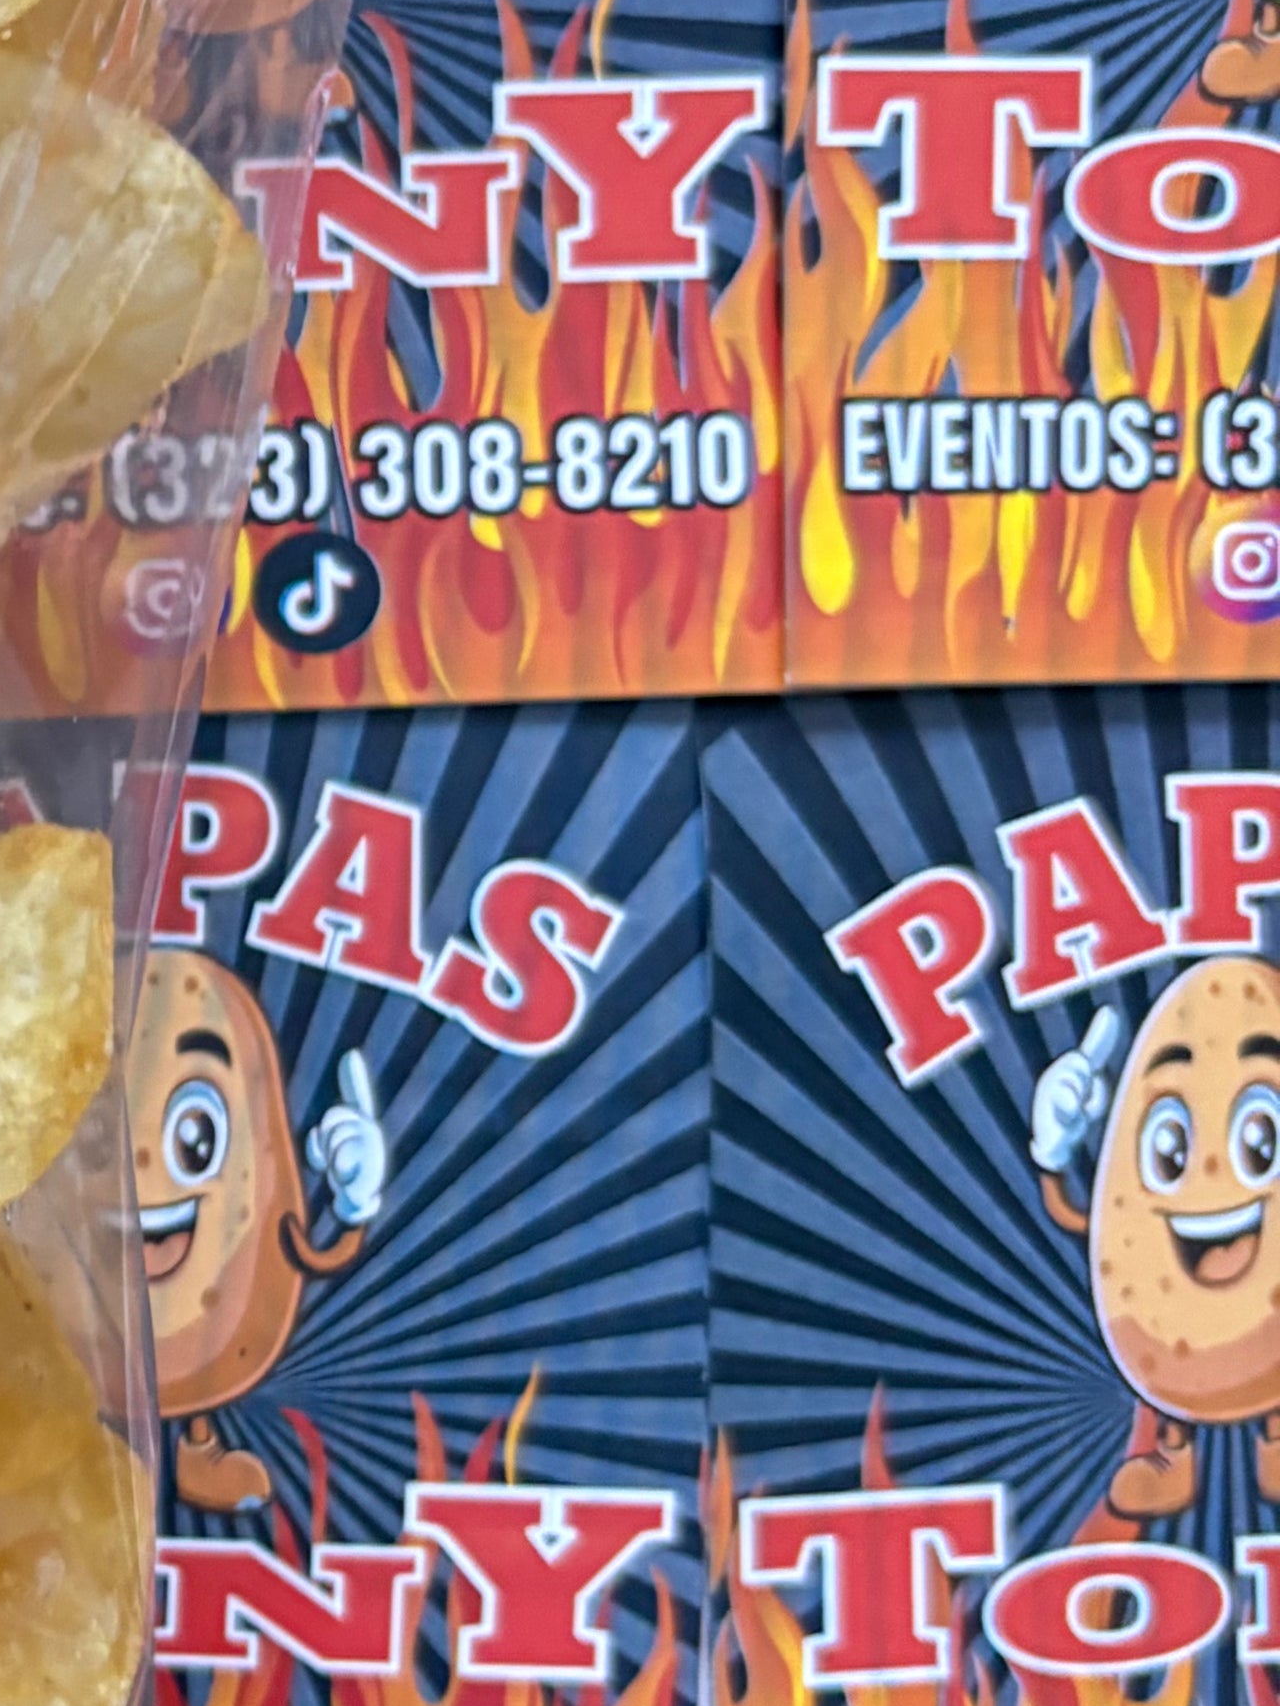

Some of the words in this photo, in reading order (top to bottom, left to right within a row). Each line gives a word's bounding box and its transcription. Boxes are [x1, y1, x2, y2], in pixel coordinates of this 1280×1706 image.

[358, 411, 748, 513] 308-8210
[842, 398, 1177, 495] EVENTOS:
[740, 1483, 1280, 1689] TO
